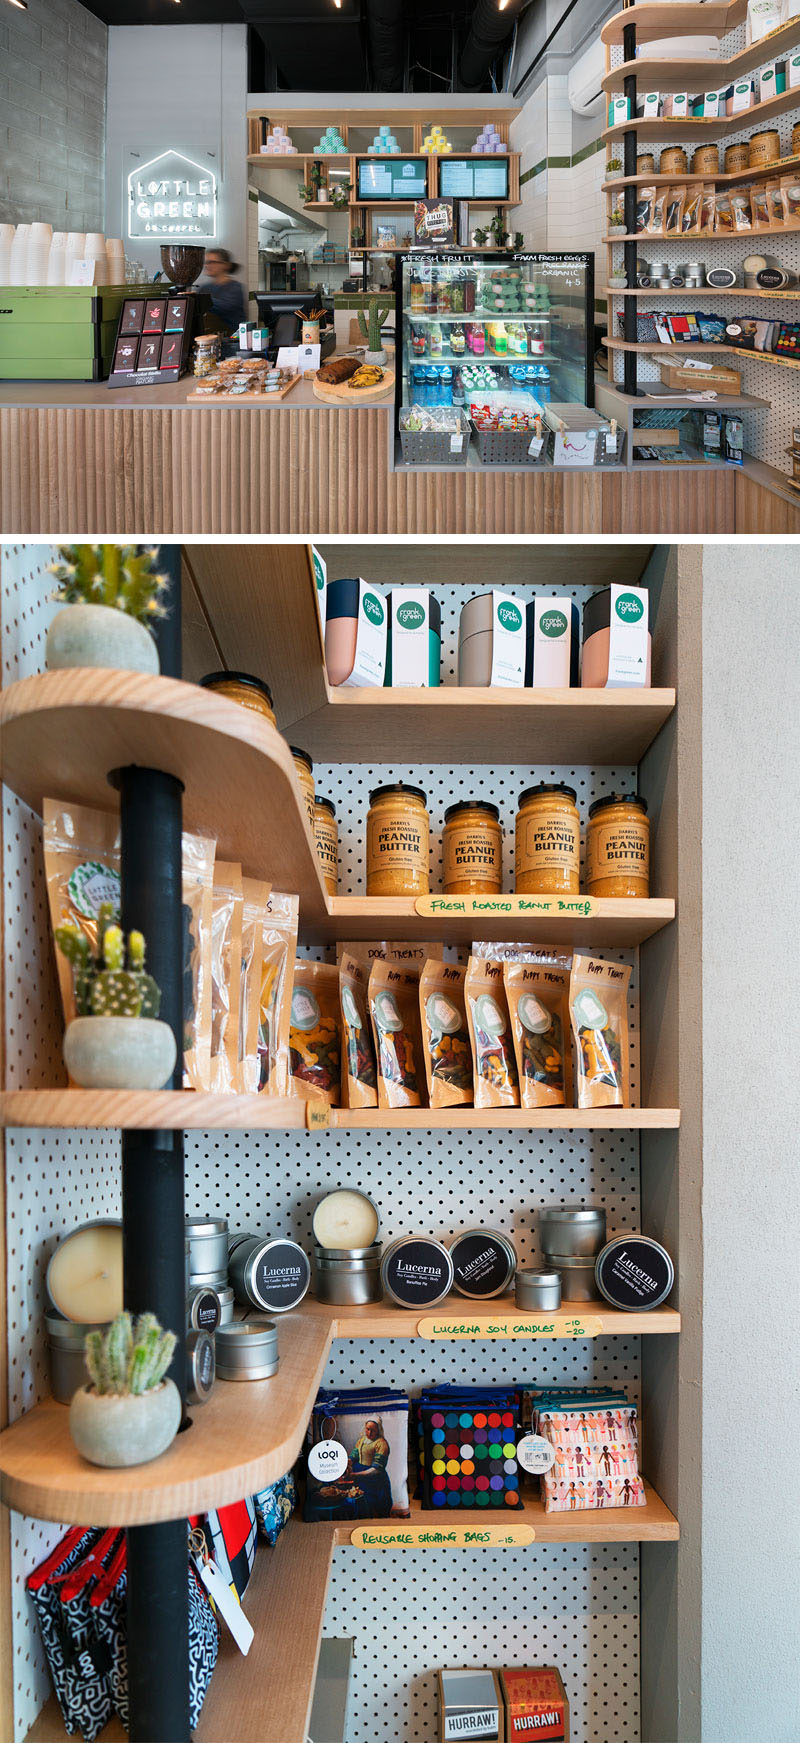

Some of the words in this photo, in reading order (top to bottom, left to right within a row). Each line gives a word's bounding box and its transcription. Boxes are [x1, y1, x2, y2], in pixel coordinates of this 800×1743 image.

[137, 201, 209, 218] GREEN
[620, 604, 640, 614] green
[402, 614, 422, 622] green
[503, 614, 520, 624] green
[545, 621, 564, 630] green
[378, 833, 421, 844] PEANUT
[534, 833, 575, 843] PEANUT
[380, 842, 420, 854] BUTTER
[455, 846, 496, 856] PEANUT
[535, 842, 574, 853] BUTTER
[606, 841, 646, 851] PEANUT
[456, 855, 495, 866] BUTTER
[607, 851, 645, 860] BUTTER
[430, 900, 466, 912] FRESH
[472, 901, 512, 910] ROASTED
[518, 900, 552, 910] PEANUT
[558, 901, 592, 911] BUTTER
[368, 950, 386, 960] DOG
[391, 948, 424, 959] TREATS
[396, 1260, 441, 1274] Lucerna
[456, 1246, 495, 1277] Lucerna
[263, 1266, 301, 1276] Lucerna
[618, 1251, 658, 1289] Lucerna
[433, 1325, 480, 1334] LUCERNA
[486, 1325, 507, 1334] SOY
[513, 1324, 554, 1334] CANDLES
[318, 1450, 338, 1460] LOQI
[362, 1533, 413, 1544] REUSABLE
[418, 1532, 456, 1543] SHOPPING
[464, 1532, 491, 1542] BAGS
[448, 1713, 496, 1730] HURRAW!
[514, 1711, 560, 1731] HURRAW!
